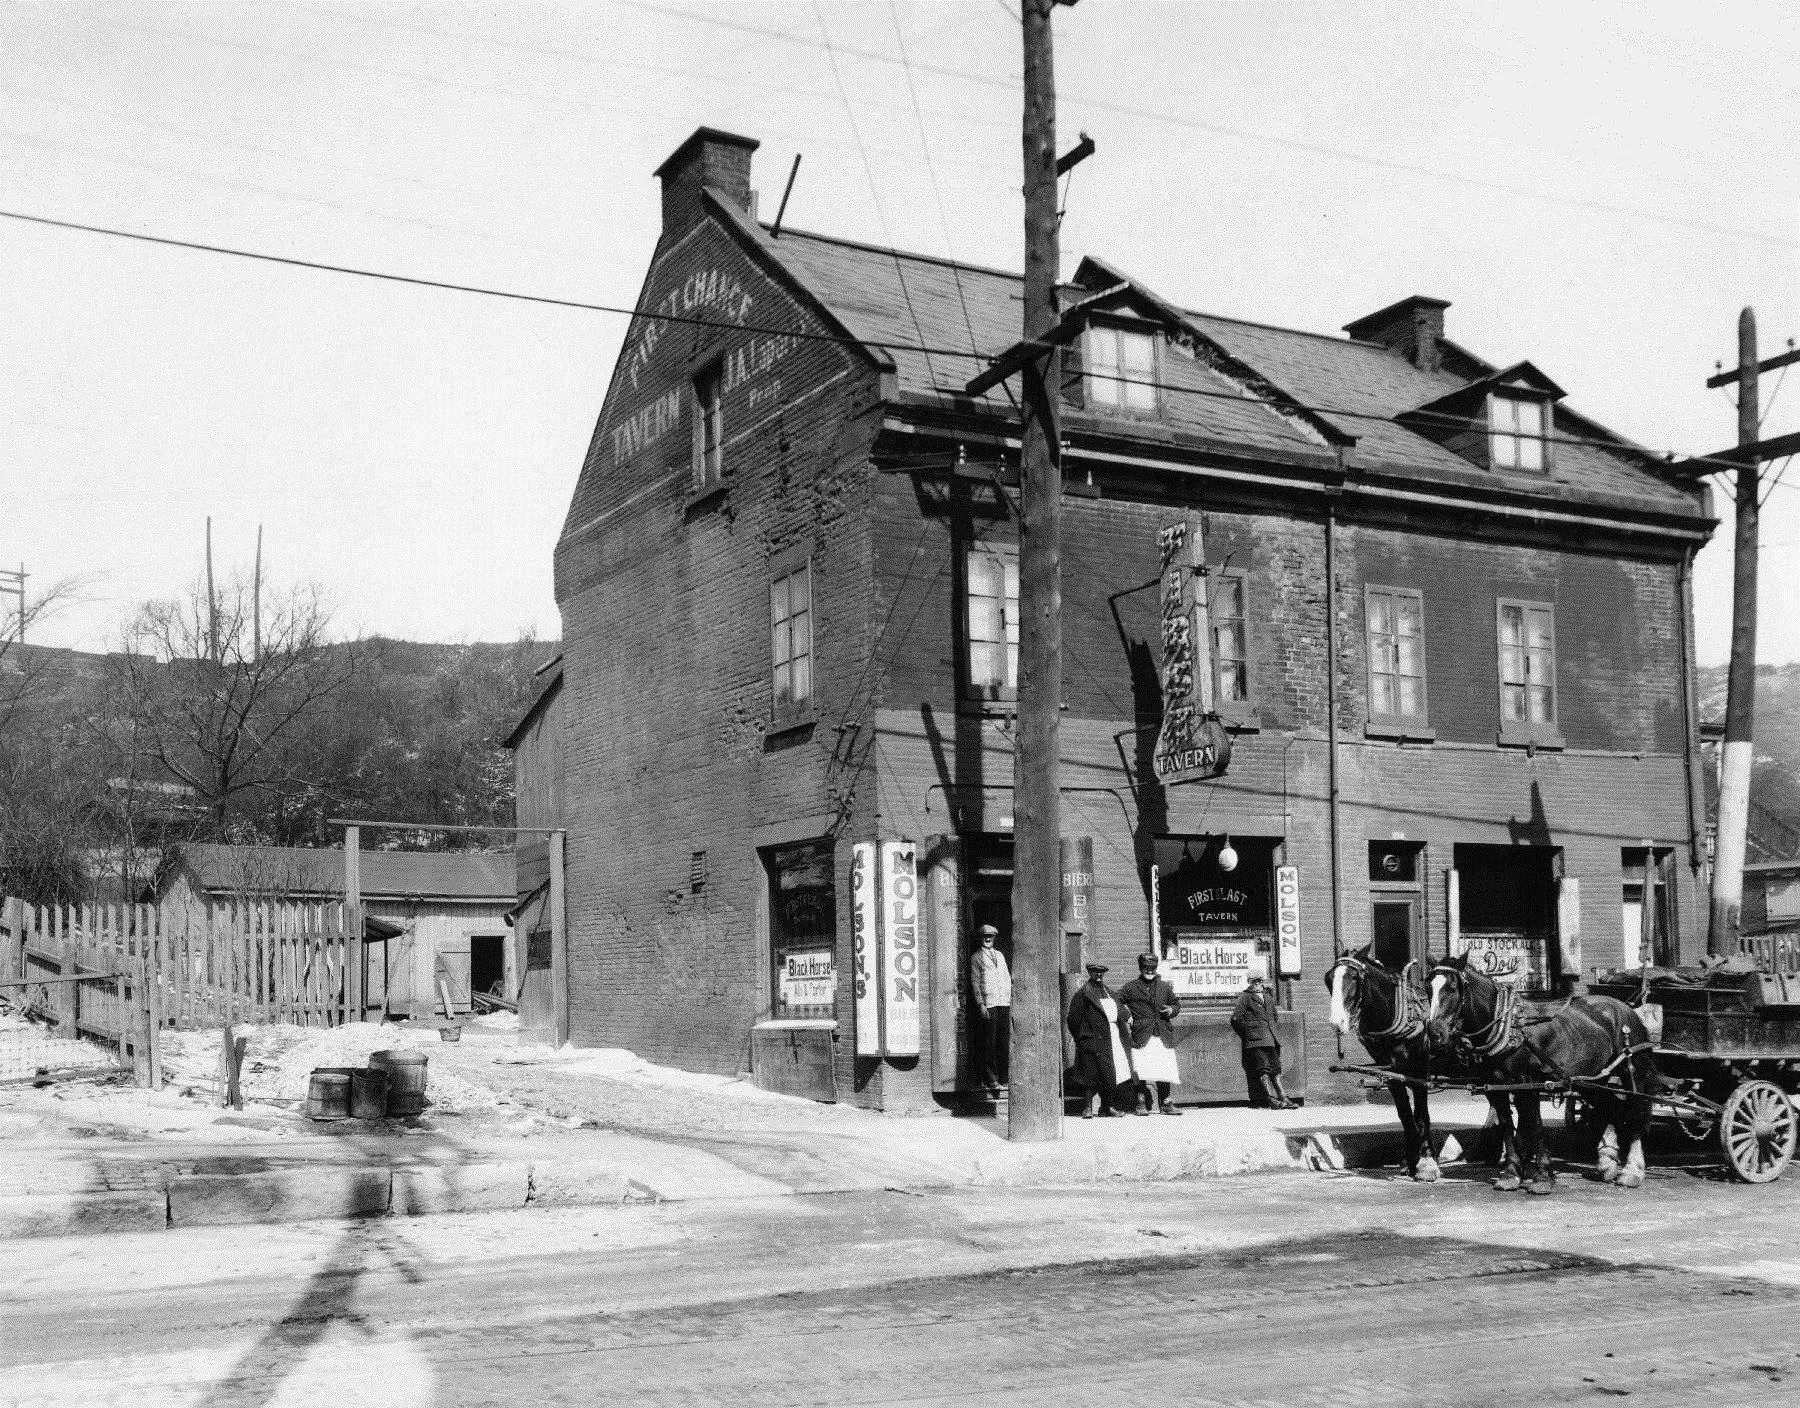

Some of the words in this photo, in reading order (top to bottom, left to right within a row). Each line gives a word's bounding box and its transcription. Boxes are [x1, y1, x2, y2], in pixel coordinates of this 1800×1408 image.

[611, 386, 680, 465] TAVERN
[1156, 744, 1217, 776] TAVERN
[1187, 888, 1214, 909] FIRST
[1198, 912, 1239, 922] TAVERN
[1279, 871, 1297, 948] MOLSON
[893, 851, 916, 1003] MOLSON
[1468, 940, 1483, 950] OLD
[1487, 939, 1518, 950] STOCK
[789, 958, 808, 976] Black
[809, 957, 831, 976] Horse
[1180, 947, 1212, 965] Black
[1214, 947, 1248, 965] Horse
[1483, 951, 1521, 974] Dow
[1188, 971, 1203, 985] Ale
[1205, 970, 1213, 985] &
[1214, 971, 1242, 985] Porter
